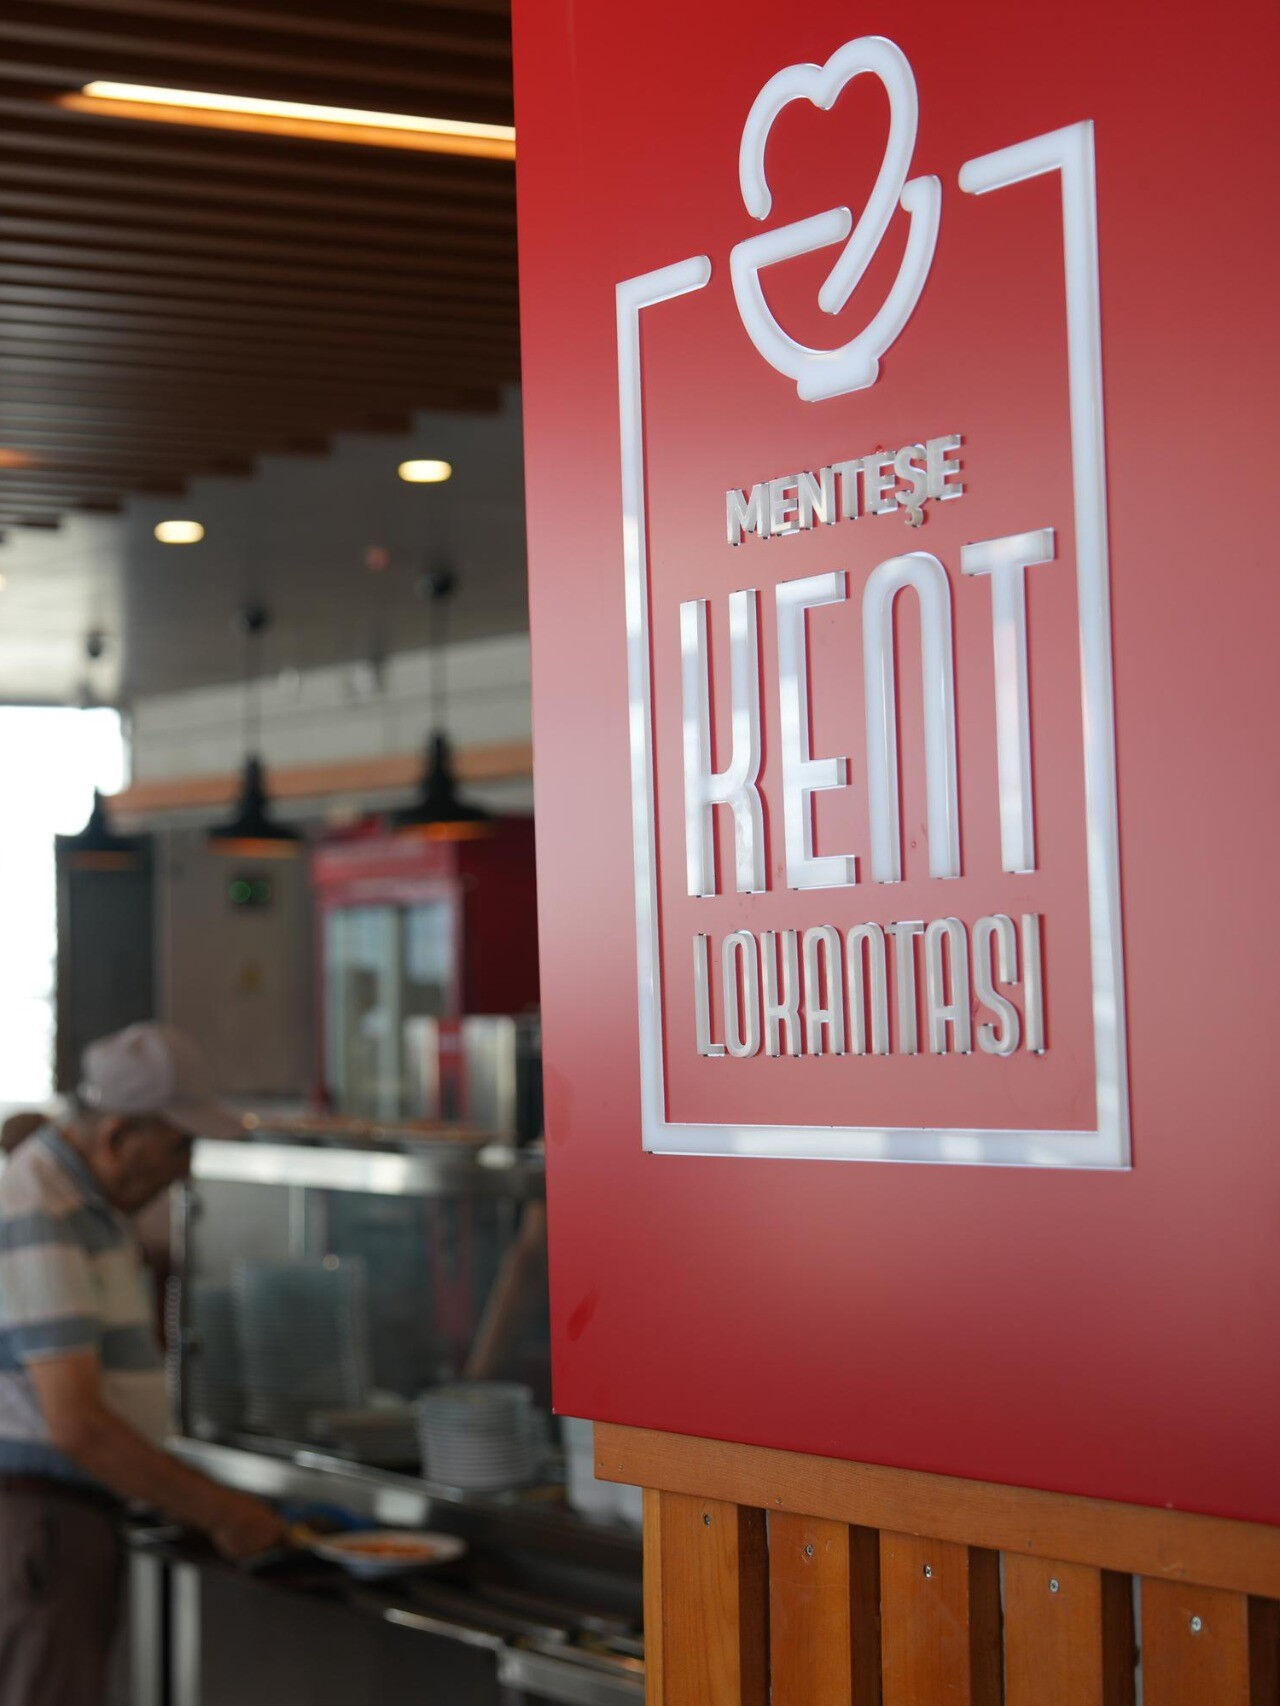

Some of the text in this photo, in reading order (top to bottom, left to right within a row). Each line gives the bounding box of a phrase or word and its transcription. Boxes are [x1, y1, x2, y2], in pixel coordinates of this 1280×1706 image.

[726, 434, 963, 546] MENTEŞE
[680, 527, 1055, 897] KENT
[694, 913, 1047, 1058] LOKANTASI
